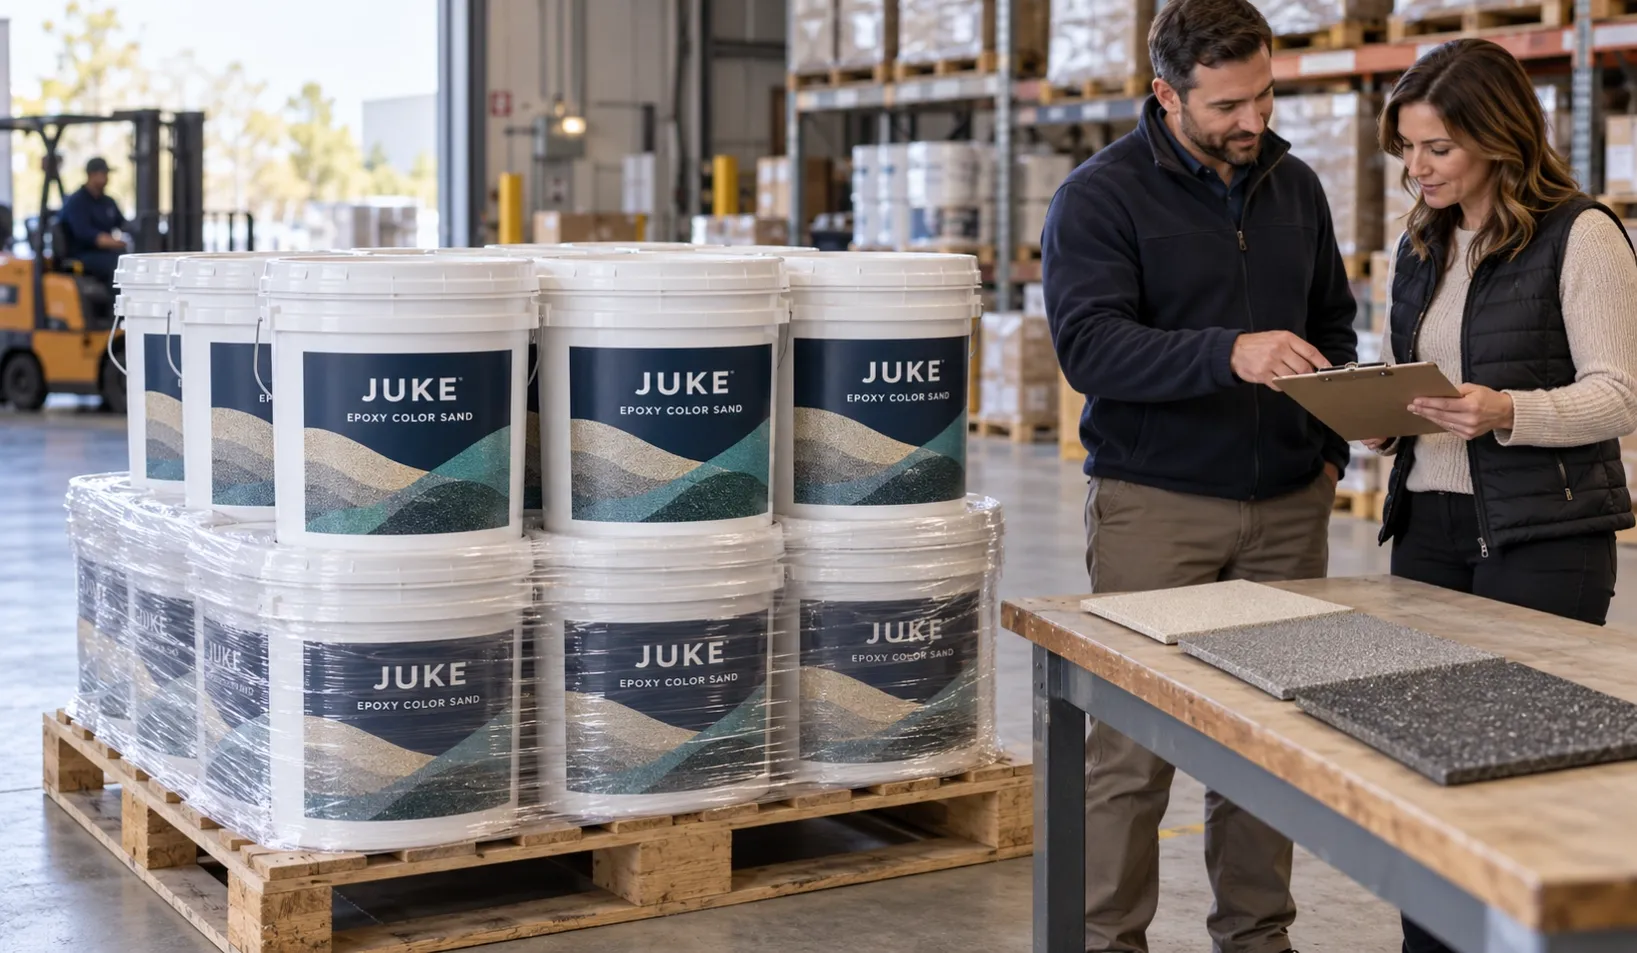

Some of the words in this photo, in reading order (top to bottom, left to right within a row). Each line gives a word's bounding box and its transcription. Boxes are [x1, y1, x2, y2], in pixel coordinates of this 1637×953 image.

[635, 371, 729, 396] JUKE
[862, 360, 941, 384] JUKE
[361, 377, 457, 402] JUKE
[847, 393, 886, 402] EPOXY
[889, 392, 925, 402] COLOR
[928, 391, 950, 401] SAND
[347, 413, 388, 422] EPOXY
[392, 413, 435, 422] COLOR
[440, 412, 473, 422] SAND
[620, 406, 662, 415] EPOXY
[666, 405, 709, 415] COLOR
[713, 404, 743, 414] SAND
[866, 619, 943, 644] JUKE
[208, 640, 241, 671] JUKE
[635, 641, 724, 668] JUKE
[851, 653, 888, 663] EPOXY
[892, 651, 927, 662] COLOR
[930, 648, 954, 659] SAND
[373, 662, 466, 690] JUKE
[620, 678, 660, 688] EPOXY
[665, 676, 705, 687] COLOR
[709, 673, 738, 684] SAND
[357, 701, 399, 711] EPOXY
[403, 700, 445, 710] COLOR
[450, 695, 480, 706] SAND
